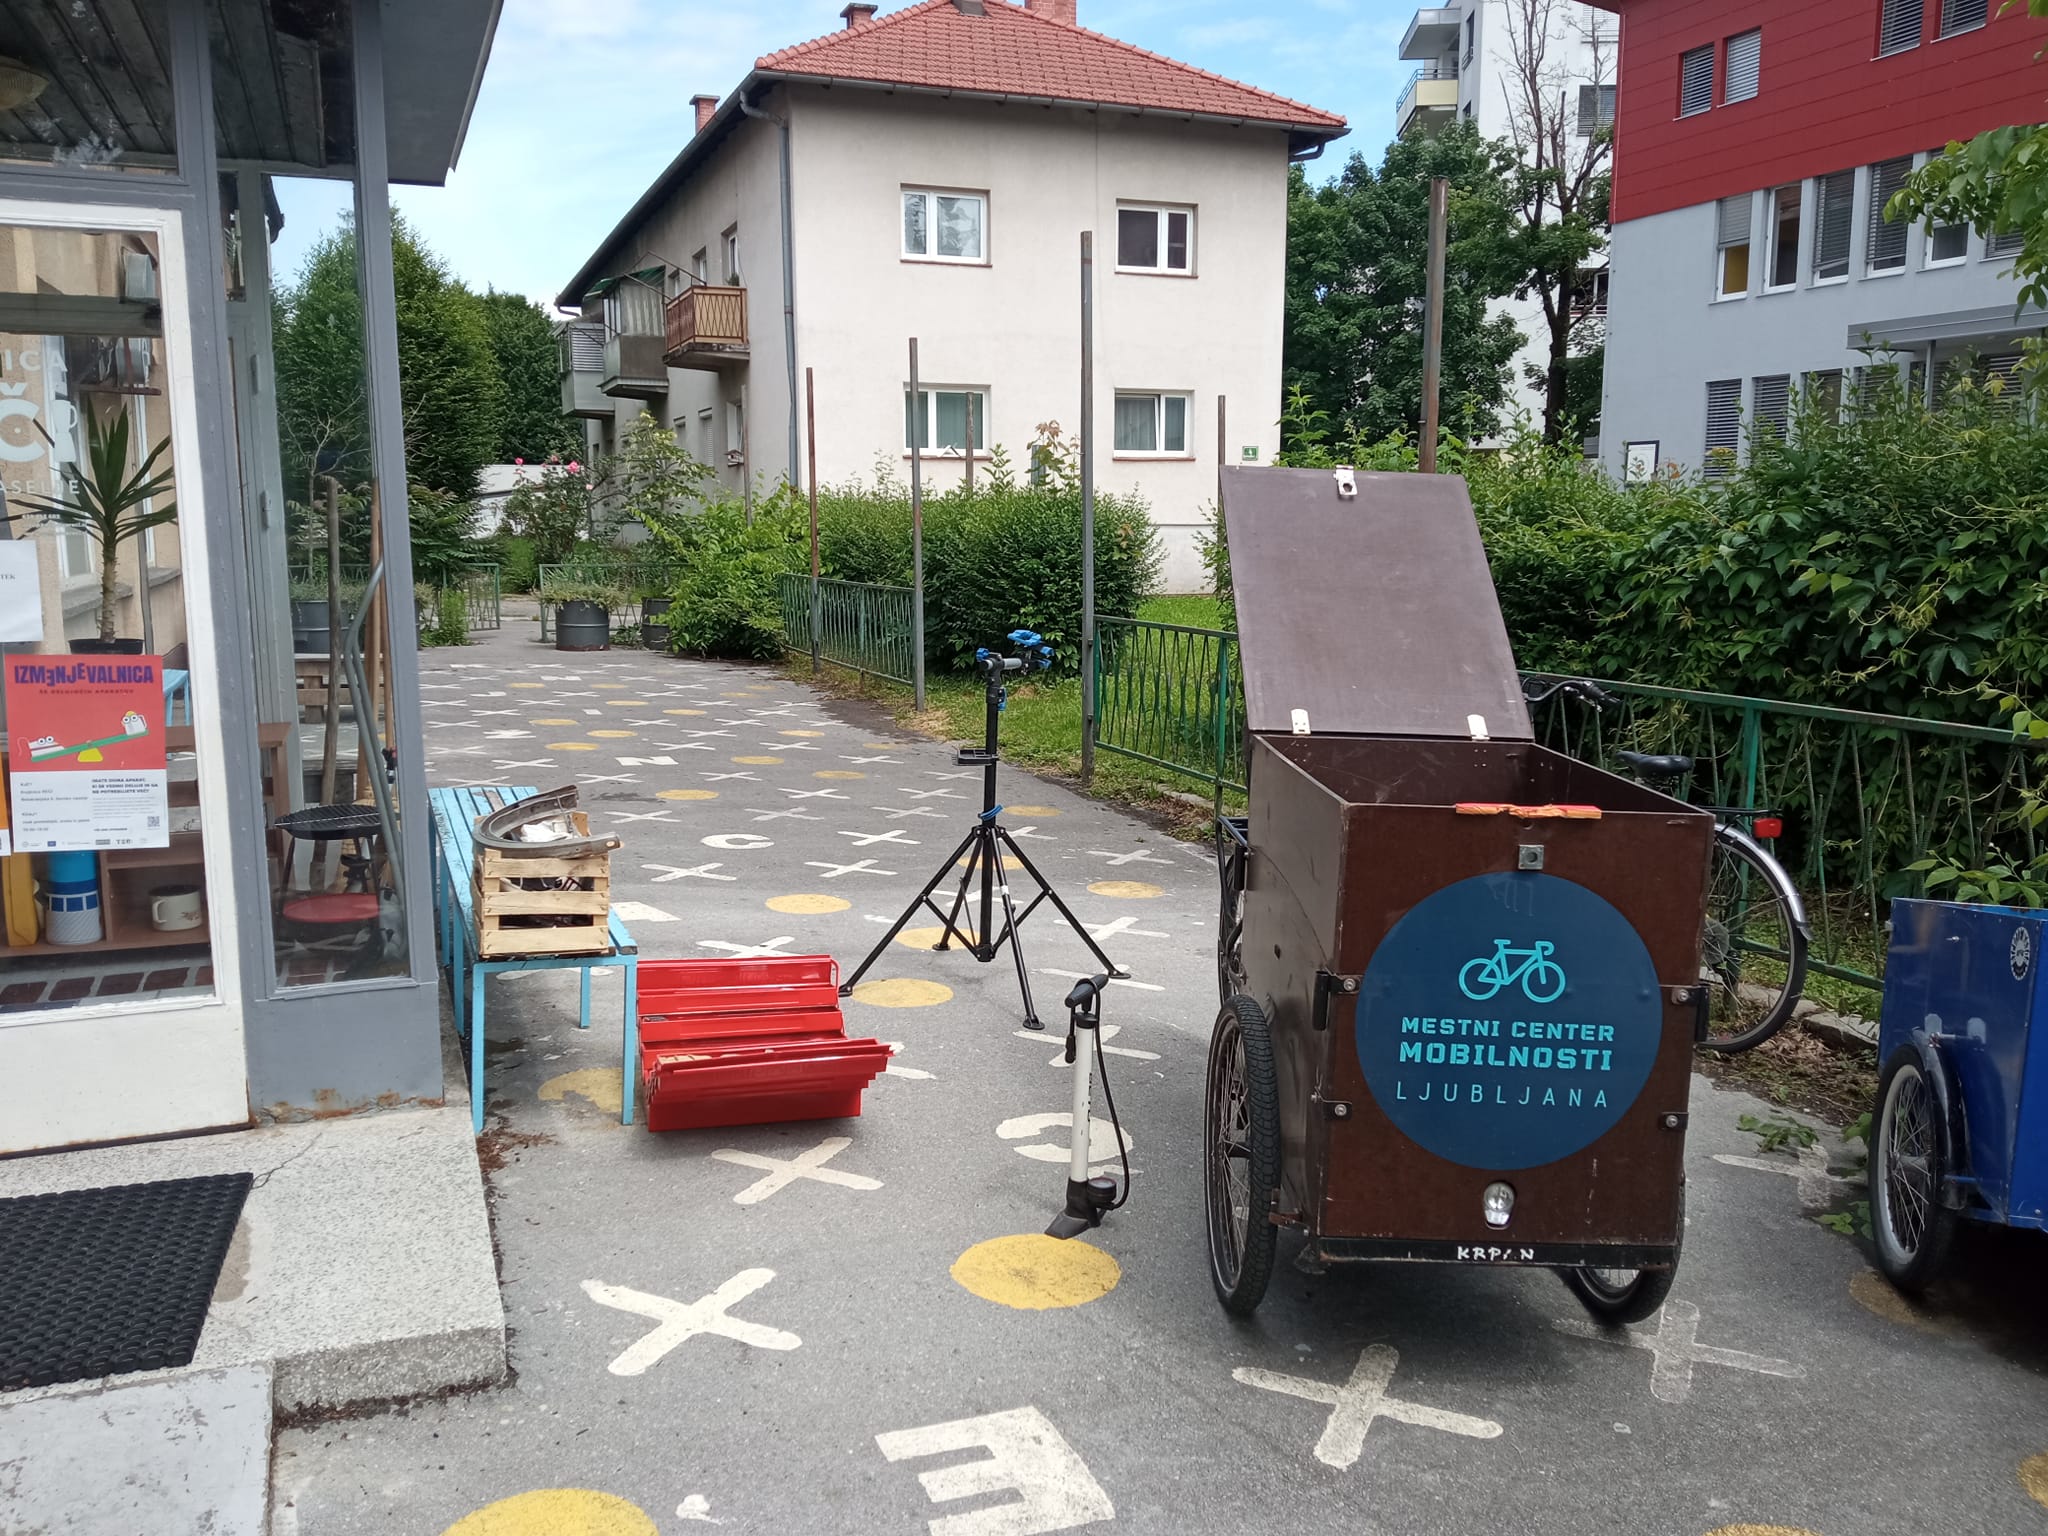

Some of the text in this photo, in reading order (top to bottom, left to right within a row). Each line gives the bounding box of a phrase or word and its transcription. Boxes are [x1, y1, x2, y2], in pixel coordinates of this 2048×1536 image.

[1402, 1016, 1615, 1042] MESTNI CENTER
[1399, 1041, 1612, 1071] MOBILNOSTI
[1396, 1081, 1607, 1108] LJUBLJANA
